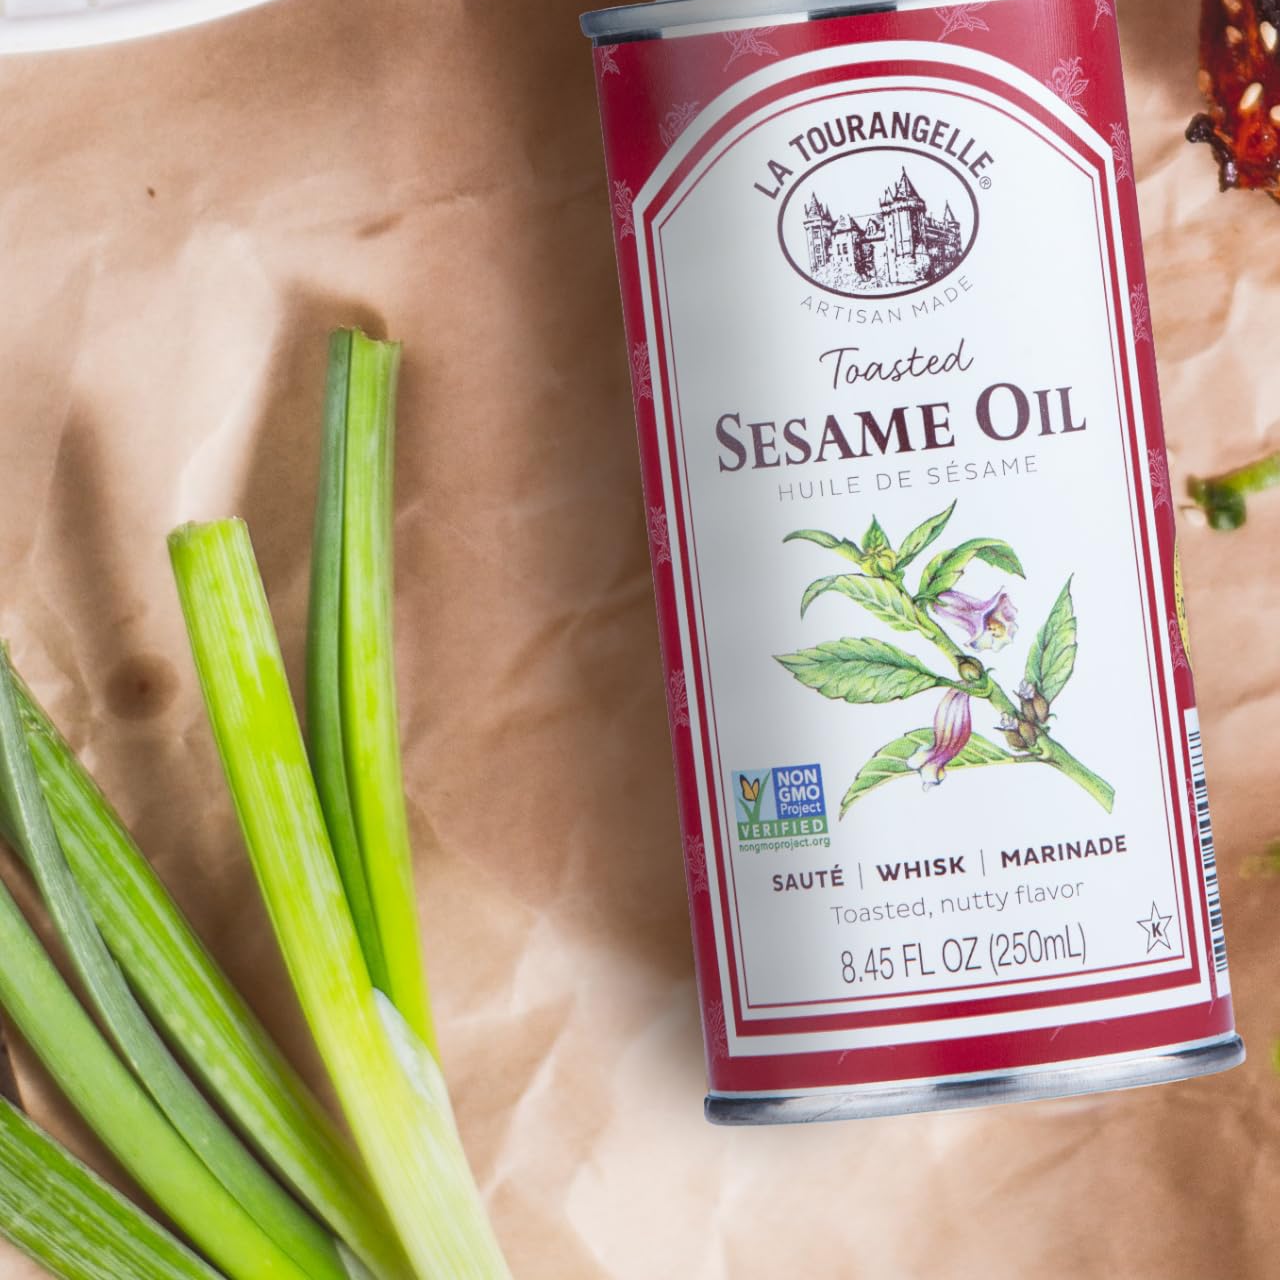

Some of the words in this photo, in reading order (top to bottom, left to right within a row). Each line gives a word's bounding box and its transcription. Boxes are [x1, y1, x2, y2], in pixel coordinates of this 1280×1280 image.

[753, 159, 794, 200] LA
[800, 295, 902, 324] ARTISAN
[911, 275, 974, 319] MADE
[819, 337, 974, 390] Toasted
[715, 402, 955, 472] SESAME
[975, 382, 1087, 441] OIL
[778, 475, 861, 502] HUILE
[876, 470, 912, 491] DE
[927, 455, 1039, 485] SÉSAME
[776, 768, 818, 787] NON
[778, 785, 820, 803] GMO
[741, 819, 824, 839] VERIFIED
[780, 802, 822, 817] Project
[739, 837, 831, 854] nongmoproject.org
[772, 864, 845, 892] SAUTÉ
[876, 855, 966, 882] WHISK
[1001, 834, 1128, 868] MARINADE
[831, 897, 933, 925] Toasted,
[941, 890, 1009, 913] nutty
[1016, 881, 1084, 905] flavor
[1151, 922, 1163, 938] K
[841, 947, 894, 984] 8.45
[902, 942, 936, 978] FL
[942, 936, 982, 973] OZ
[989, 922, 1086, 976] (250mL)
